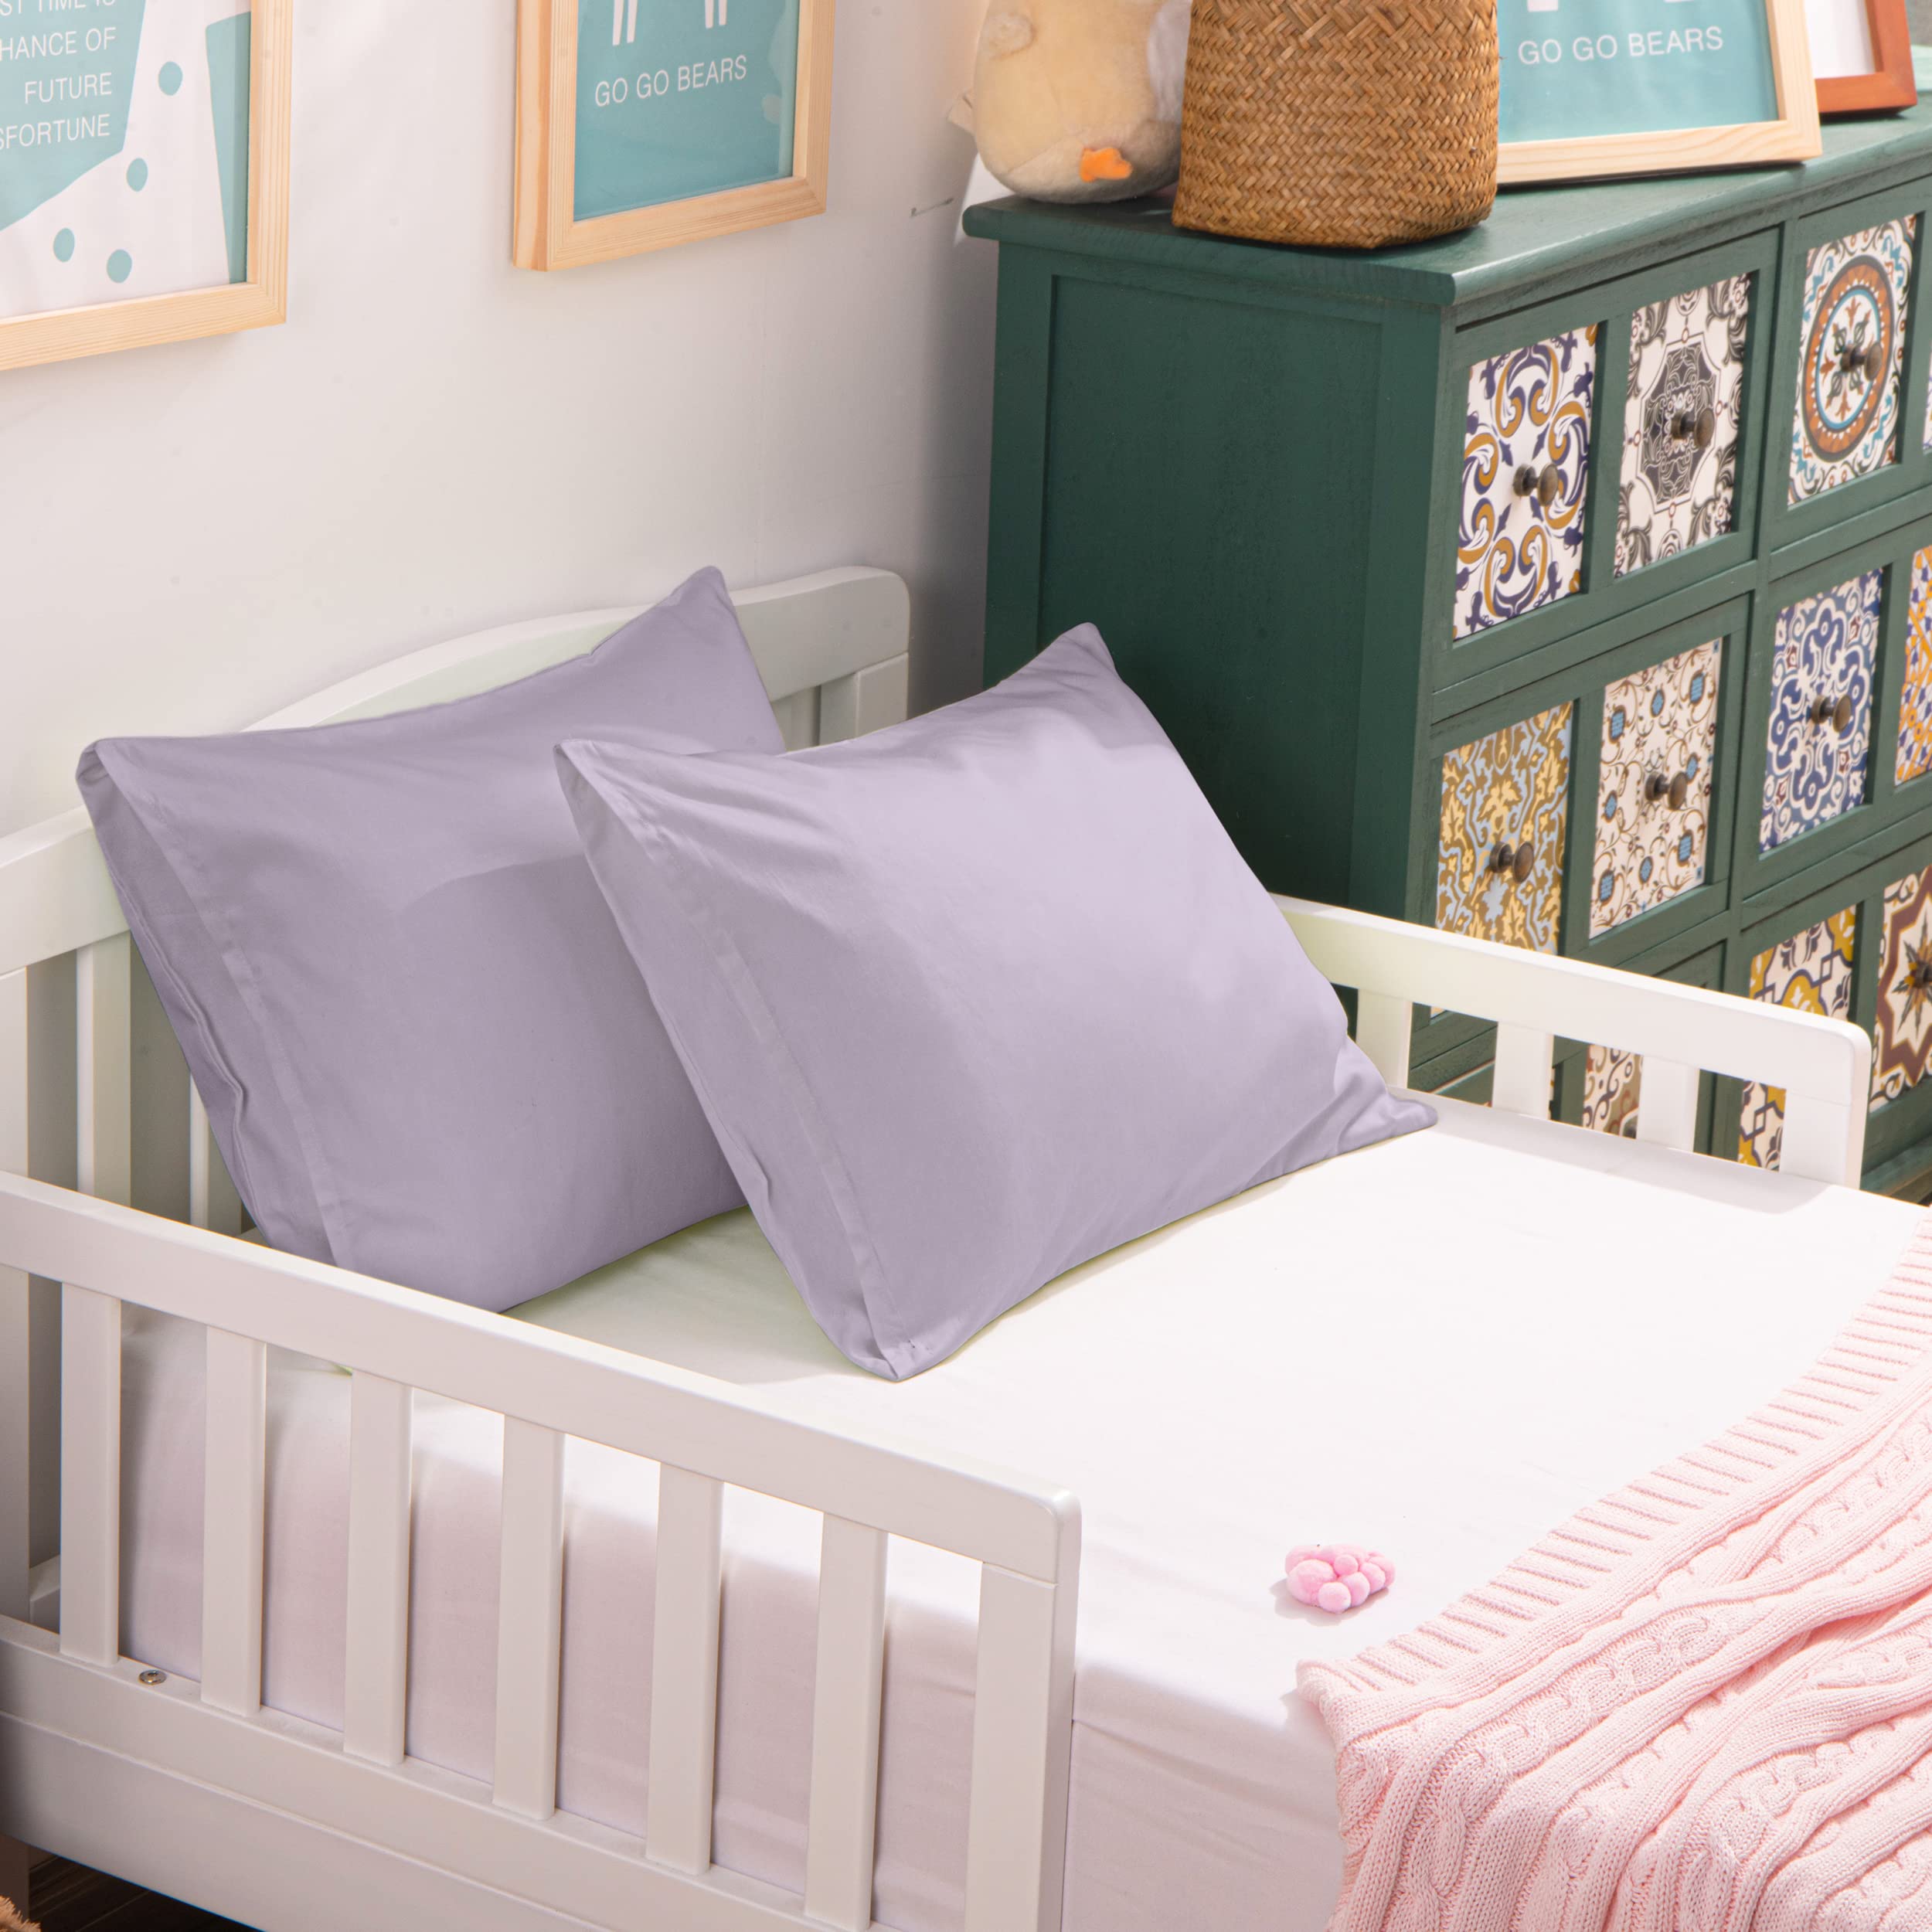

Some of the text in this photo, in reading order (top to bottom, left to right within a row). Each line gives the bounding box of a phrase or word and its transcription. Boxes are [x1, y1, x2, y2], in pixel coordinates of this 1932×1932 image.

[0, 26, 117, 62] HANCE OF
[1518, 26, 1724, 65] GO GO BEARS
[25, 72, 112, 104] FUTURE
[594, 54, 747, 107] GO GO BEARS
